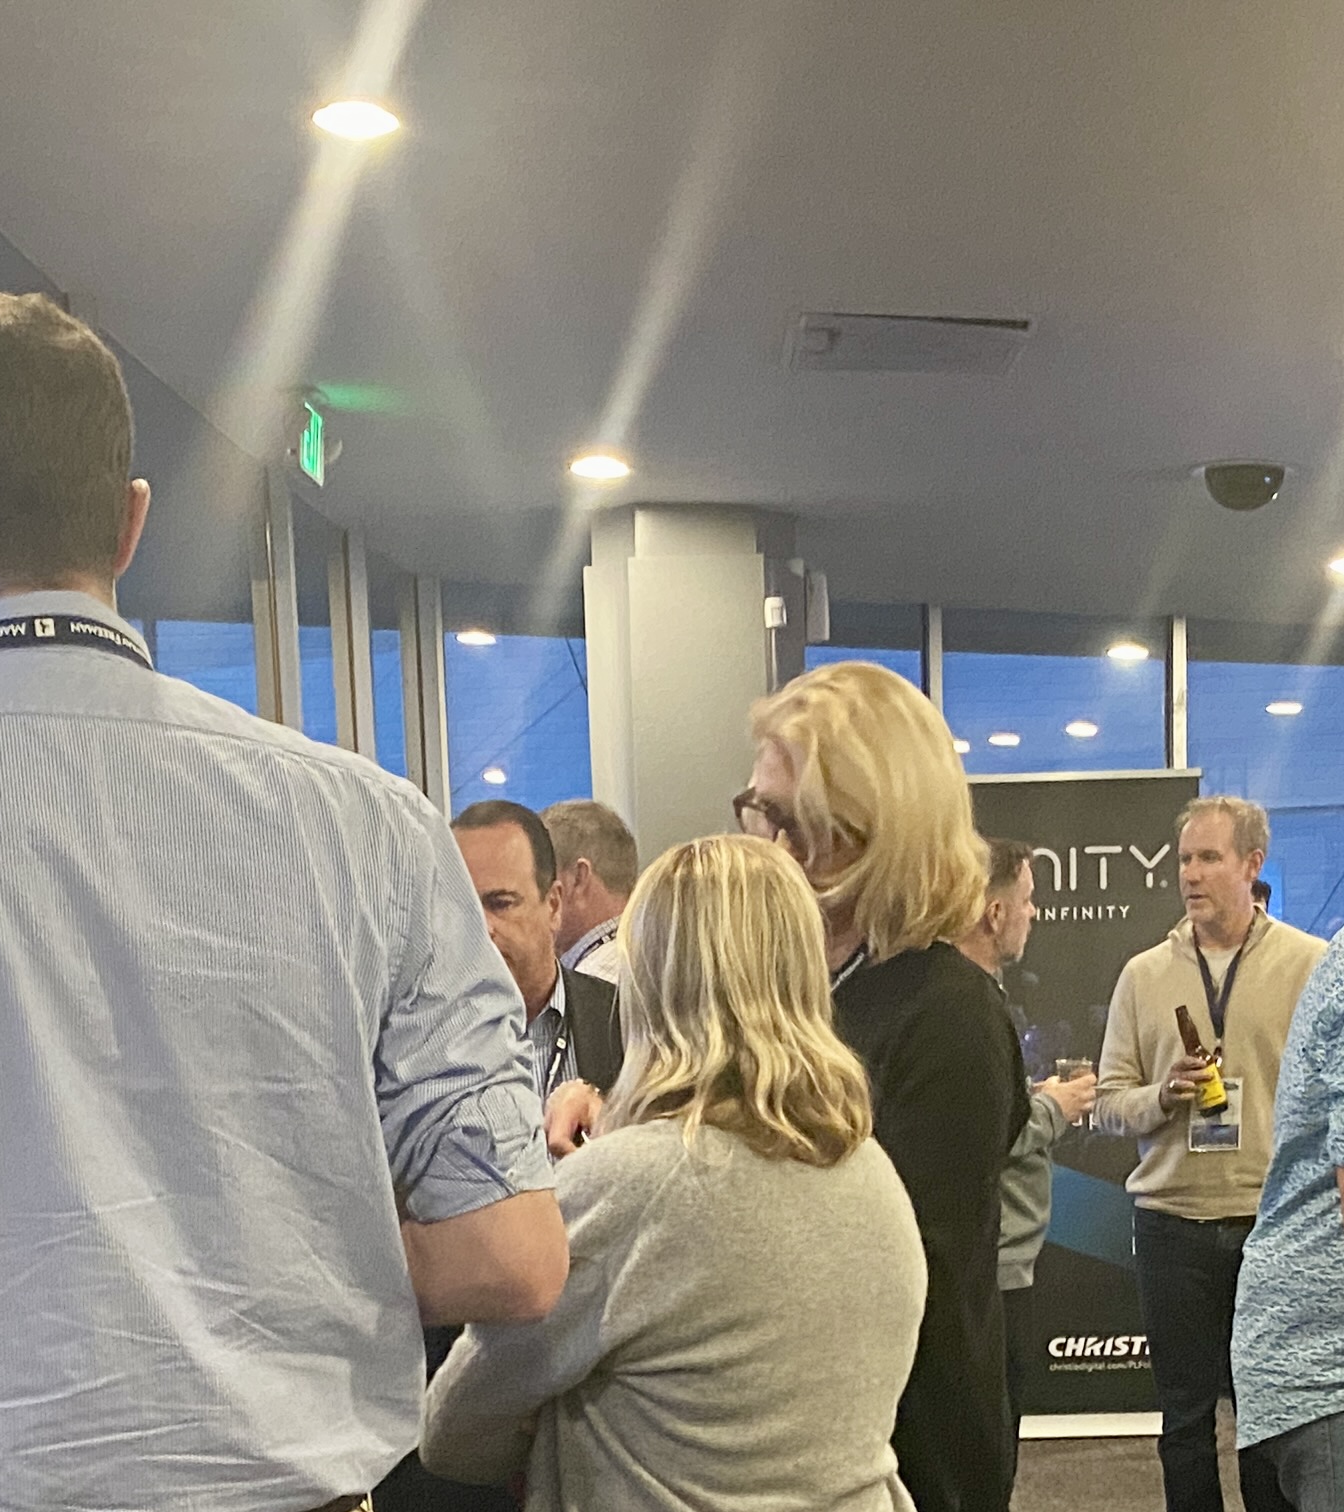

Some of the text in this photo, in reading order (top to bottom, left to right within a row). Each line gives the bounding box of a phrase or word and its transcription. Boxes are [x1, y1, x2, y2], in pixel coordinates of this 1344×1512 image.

[1032, 843, 1171, 892] NITY
[1035, 905, 1130, 921] INFINITY
[1047, 1335, 1151, 1358] CHRIST
